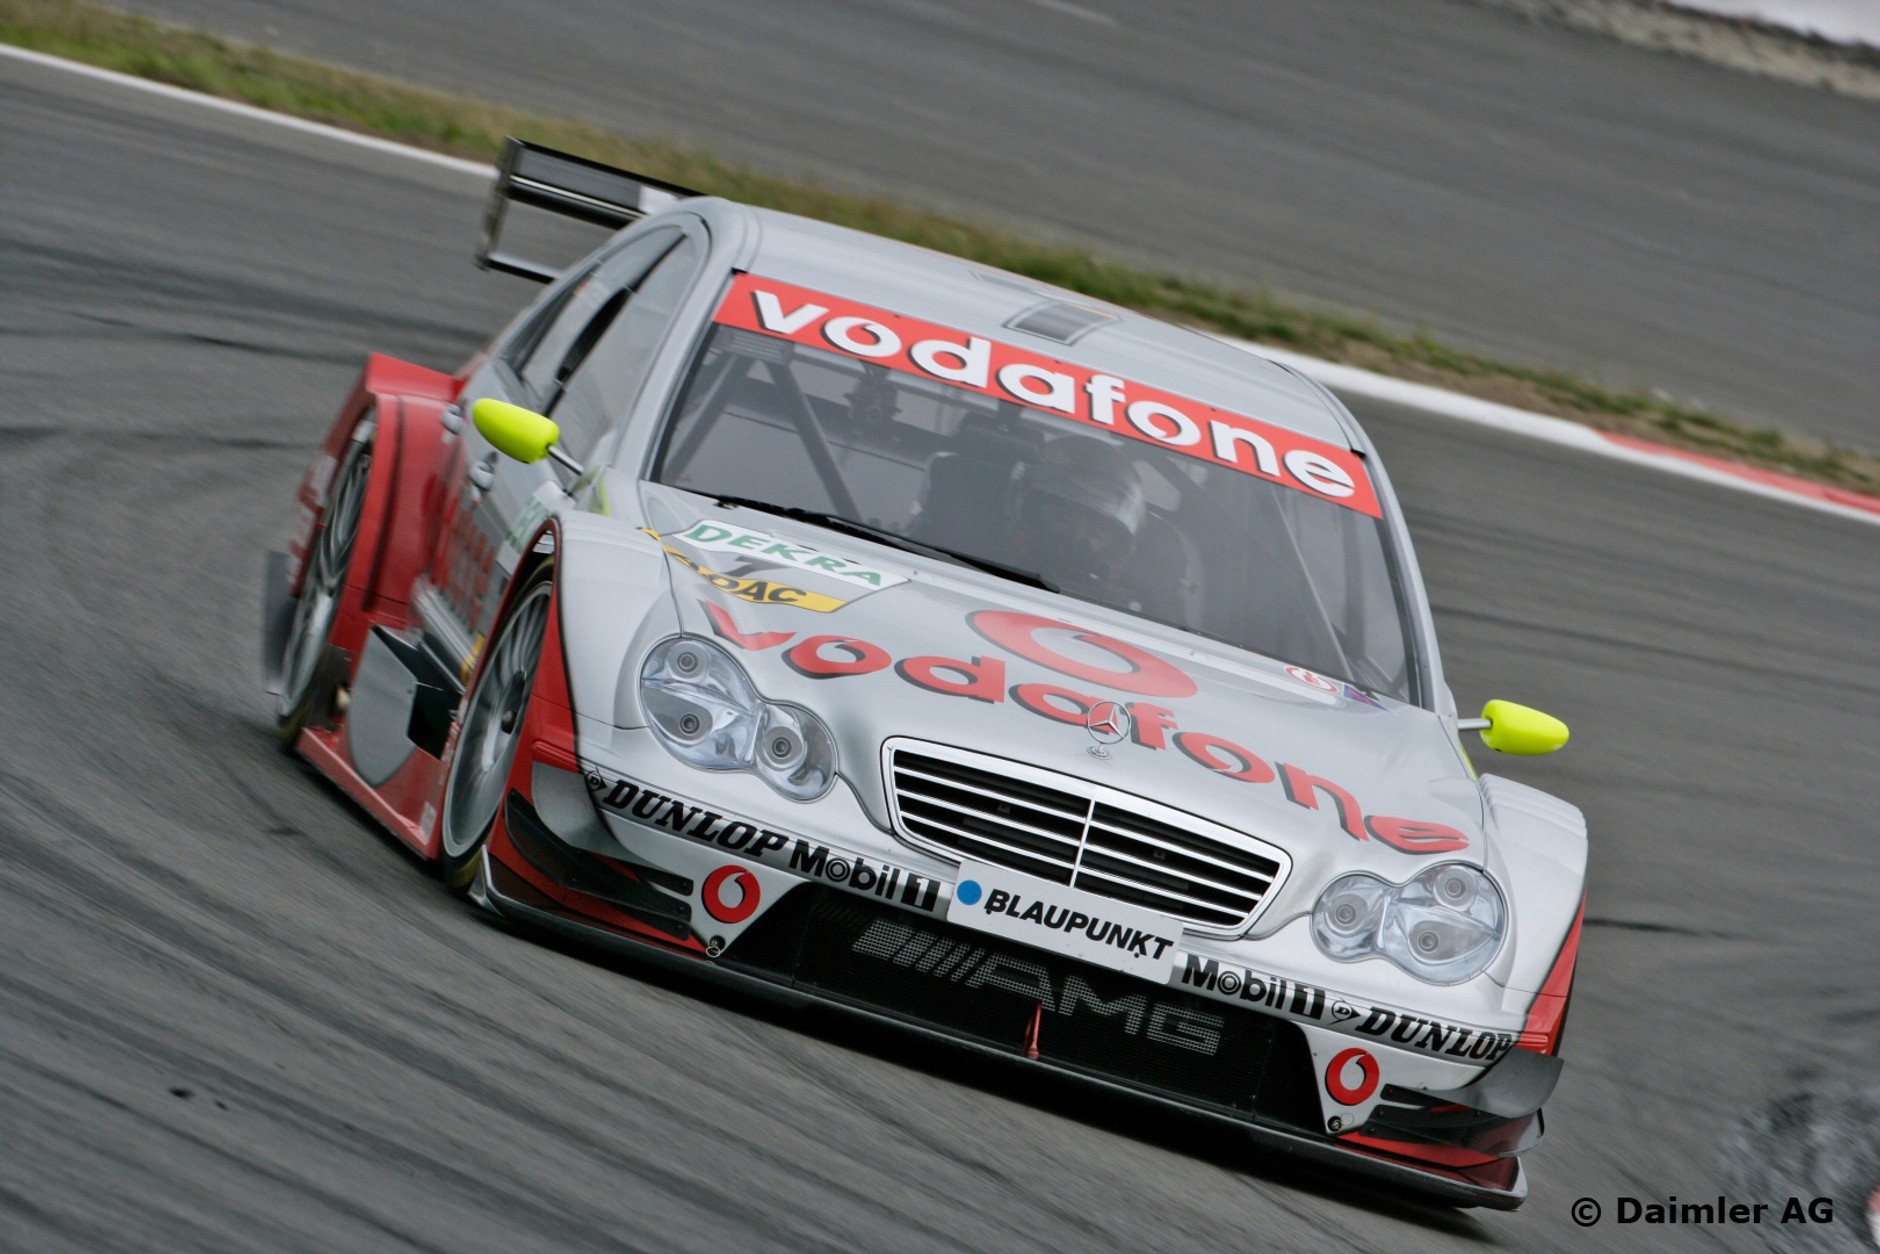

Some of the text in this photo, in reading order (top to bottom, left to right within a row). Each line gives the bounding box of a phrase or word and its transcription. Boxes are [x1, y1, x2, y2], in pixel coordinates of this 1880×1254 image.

[752, 289, 1355, 498] vodafone
[684, 525, 883, 586] DEKRA
[697, 598, 1470, 855] vodafone
[603, 780, 790, 857] DUNLOP
[789, 838, 901, 899] Mobil
[984, 889, 1174, 960] BLAUPUNKT
[966, 952, 1224, 1055] AMG
[1182, 954, 1288, 1009] Mobil
[1355, 1006, 1512, 1060] DUNLOP
